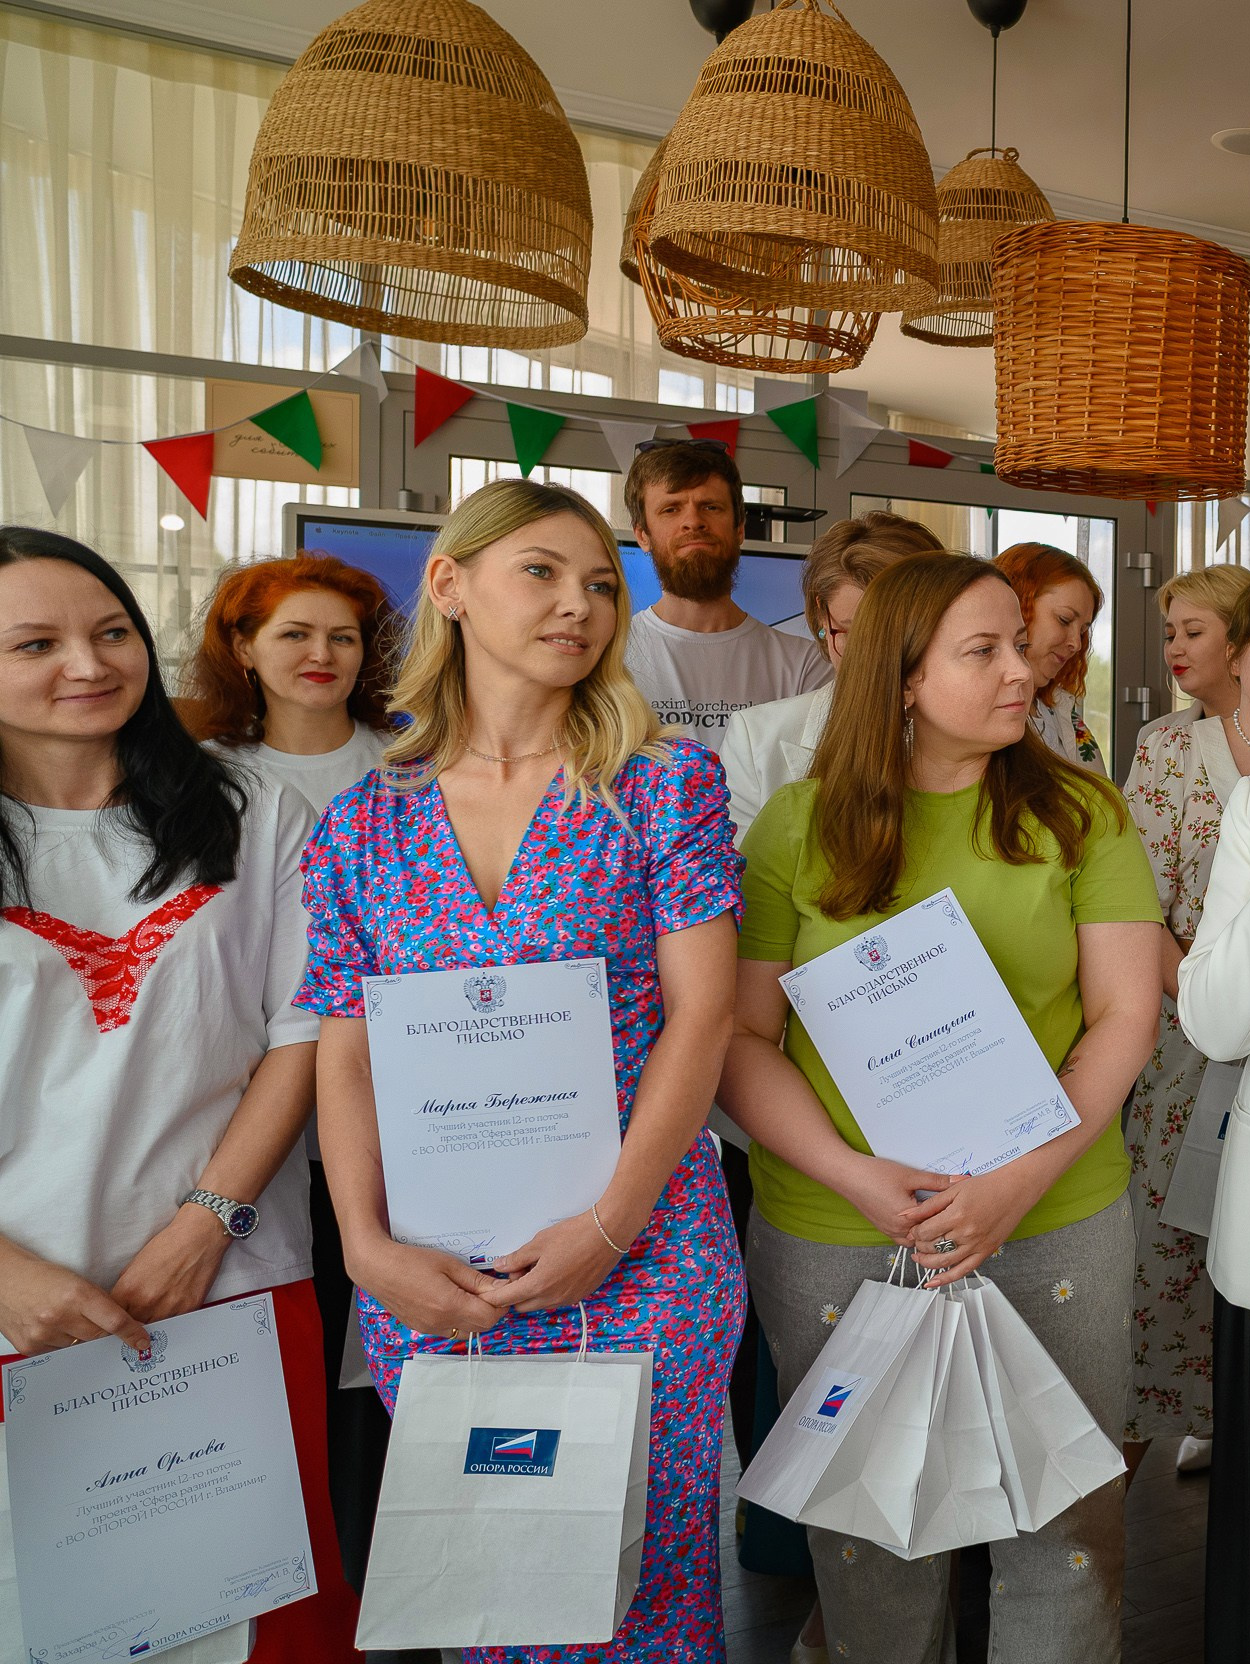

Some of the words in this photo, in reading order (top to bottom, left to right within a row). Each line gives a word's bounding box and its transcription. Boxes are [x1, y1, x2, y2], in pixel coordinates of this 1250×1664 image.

[332, 527, 359, 536] Keynote
[651, 698, 686, 709] axim
[657, 711, 731, 728] RODUCT
[827, 943, 947, 1011] БЛАГОДАРСТВЕННОЕ
[867, 972, 918, 1004] ПИСЬМО
[406, 1010, 572, 1036] БЛАГОДАРСТВЕННОЕ
[456, 1028, 525, 1045] ПИСЬМО
[867, 1048, 903, 1071] Ольга
[905, 1009, 977, 1049] Синицына
[879, 1066, 909, 1085] Лучший
[908, 1051, 940, 1072] участник
[958, 1027, 982, 1044] потока
[881, 1094, 894, 1107] ВО
[893, 1074, 931, 1099] ОПОРОЙ
[930, 1057, 965, 1081] РОССИИ
[970, 1036, 1006, 1060] Владимир
[892, 1071, 921, 1089] проекта
[413, 1099, 478, 1116] Мария
[484, 1089, 579, 1111] Бережная
[427, 1121, 467, 1133] Лучший
[467, 1118, 511, 1131] участник
[512, 1115, 535, 1125] 12-го
[537, 1112, 569, 1122] потока
[419, 1146, 435, 1155] ВО
[436, 1139, 487, 1153] ОПОРОЙ
[487, 1136, 534, 1149] РОССИИ
[544, 1130, 591, 1144] Владимир
[440, 1132, 478, 1144] проекта
[971, 1160, 996, 1176] ОПОРА
[993, 1146, 1021, 1164] РОССИИ
[53, 1352, 240, 1415] БЛАГОДАРСТВЕННОЕ
[111, 1381, 189, 1412] ПИСЬМО
[799, 1415, 819, 1431] ОПОРА
[85, 1465, 149, 1492] Анна
[157, 1438, 227, 1471] Орлова
[470, 1463, 506, 1473] ОПОРА
[507, 1464, 549, 1474] РОССИИ
[76, 1495, 125, 1517] Лучший
[125, 1478, 178, 1502] участник
[178, 1470, 205, 1485] 12-го
[206, 1459, 243, 1477] потока
[55, 1541, 63, 1549] с
[65, 1530, 86, 1546] ВО
[87, 1510, 149, 1538] ОПОРОЙ
[149, 1493, 205, 1518] РОССИИ
[215, 1473, 268, 1497] Владимир
[92, 1502, 139, 1525] проекта
[151, 1629, 187, 1648] ОПОРА
[188, 1613, 231, 1635] РОССИИ
[54, 1641, 98, 1661] Захаров
